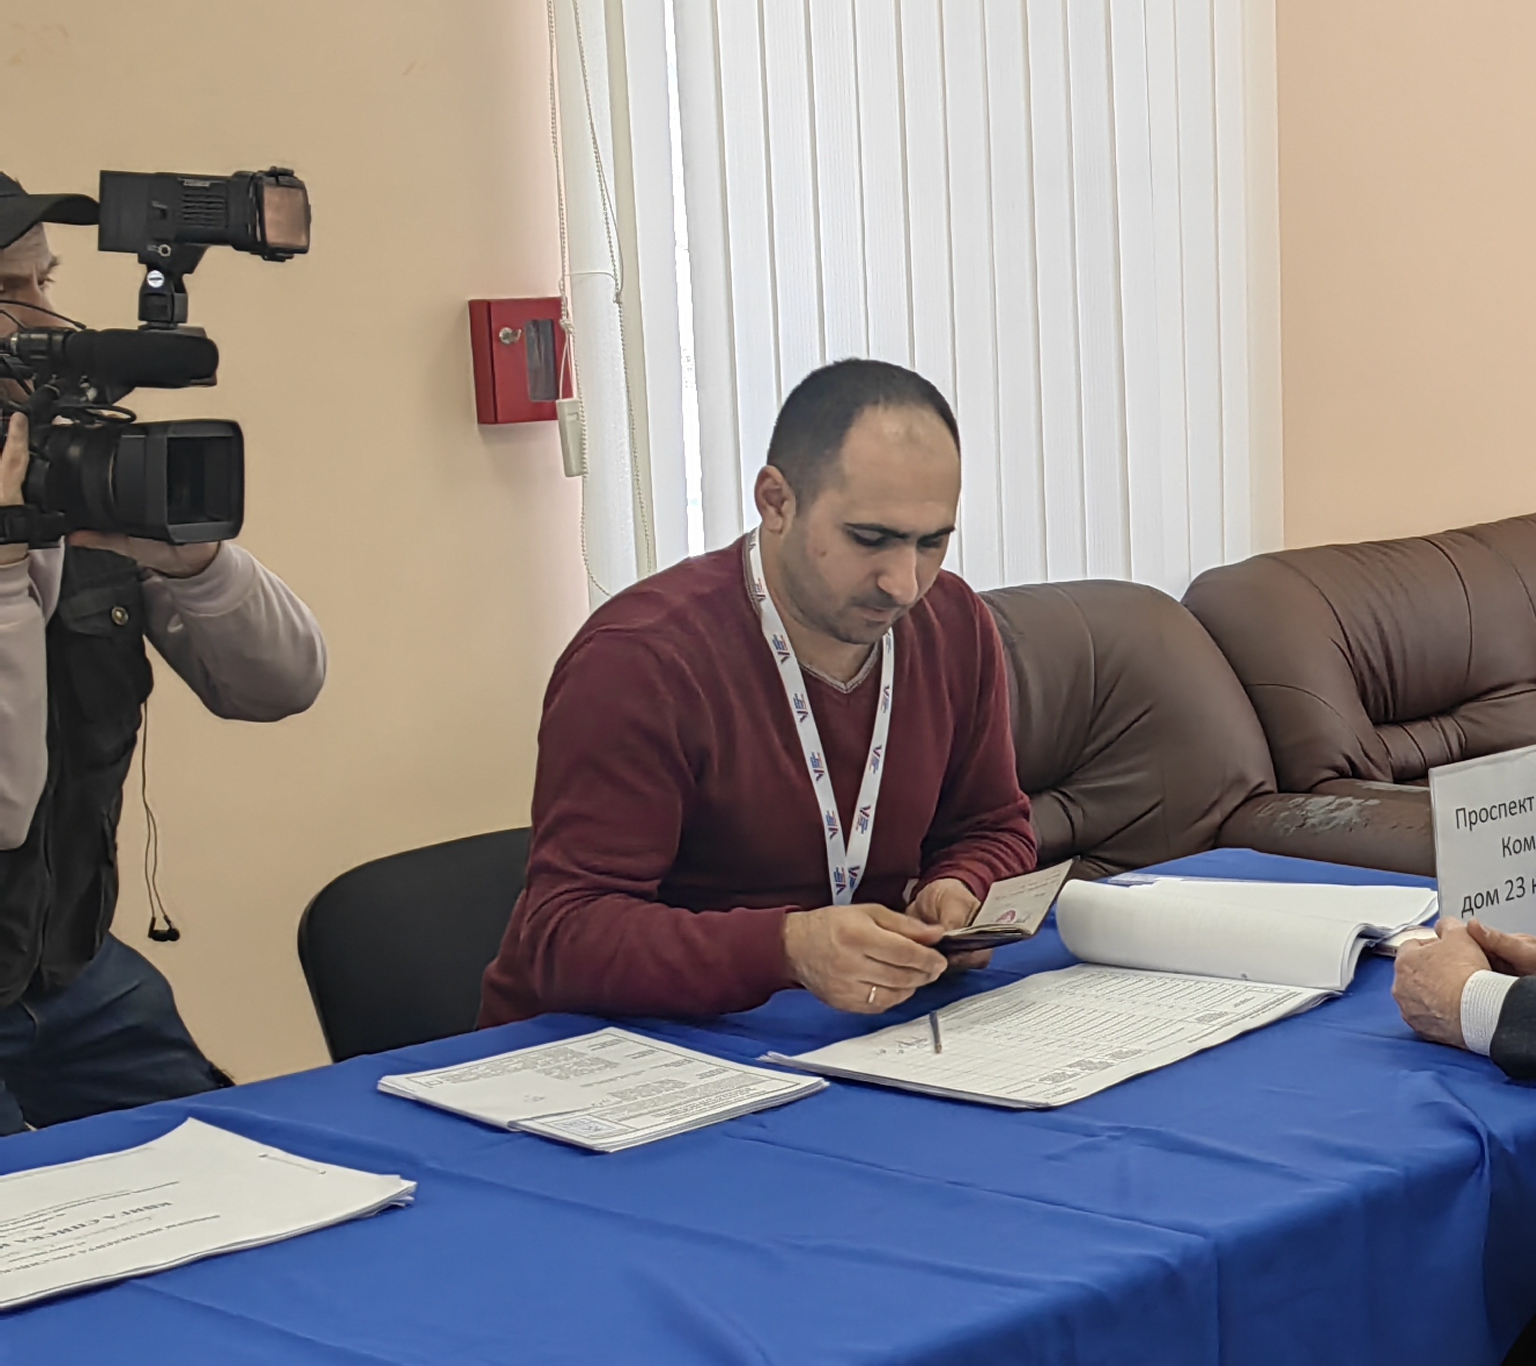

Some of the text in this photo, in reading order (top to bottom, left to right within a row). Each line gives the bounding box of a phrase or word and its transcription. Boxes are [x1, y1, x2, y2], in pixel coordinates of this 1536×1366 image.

[1455, 795, 1535, 831] Проспект
[1461, 889, 1500, 918] дом
[1504, 876, 1526, 902] 23
